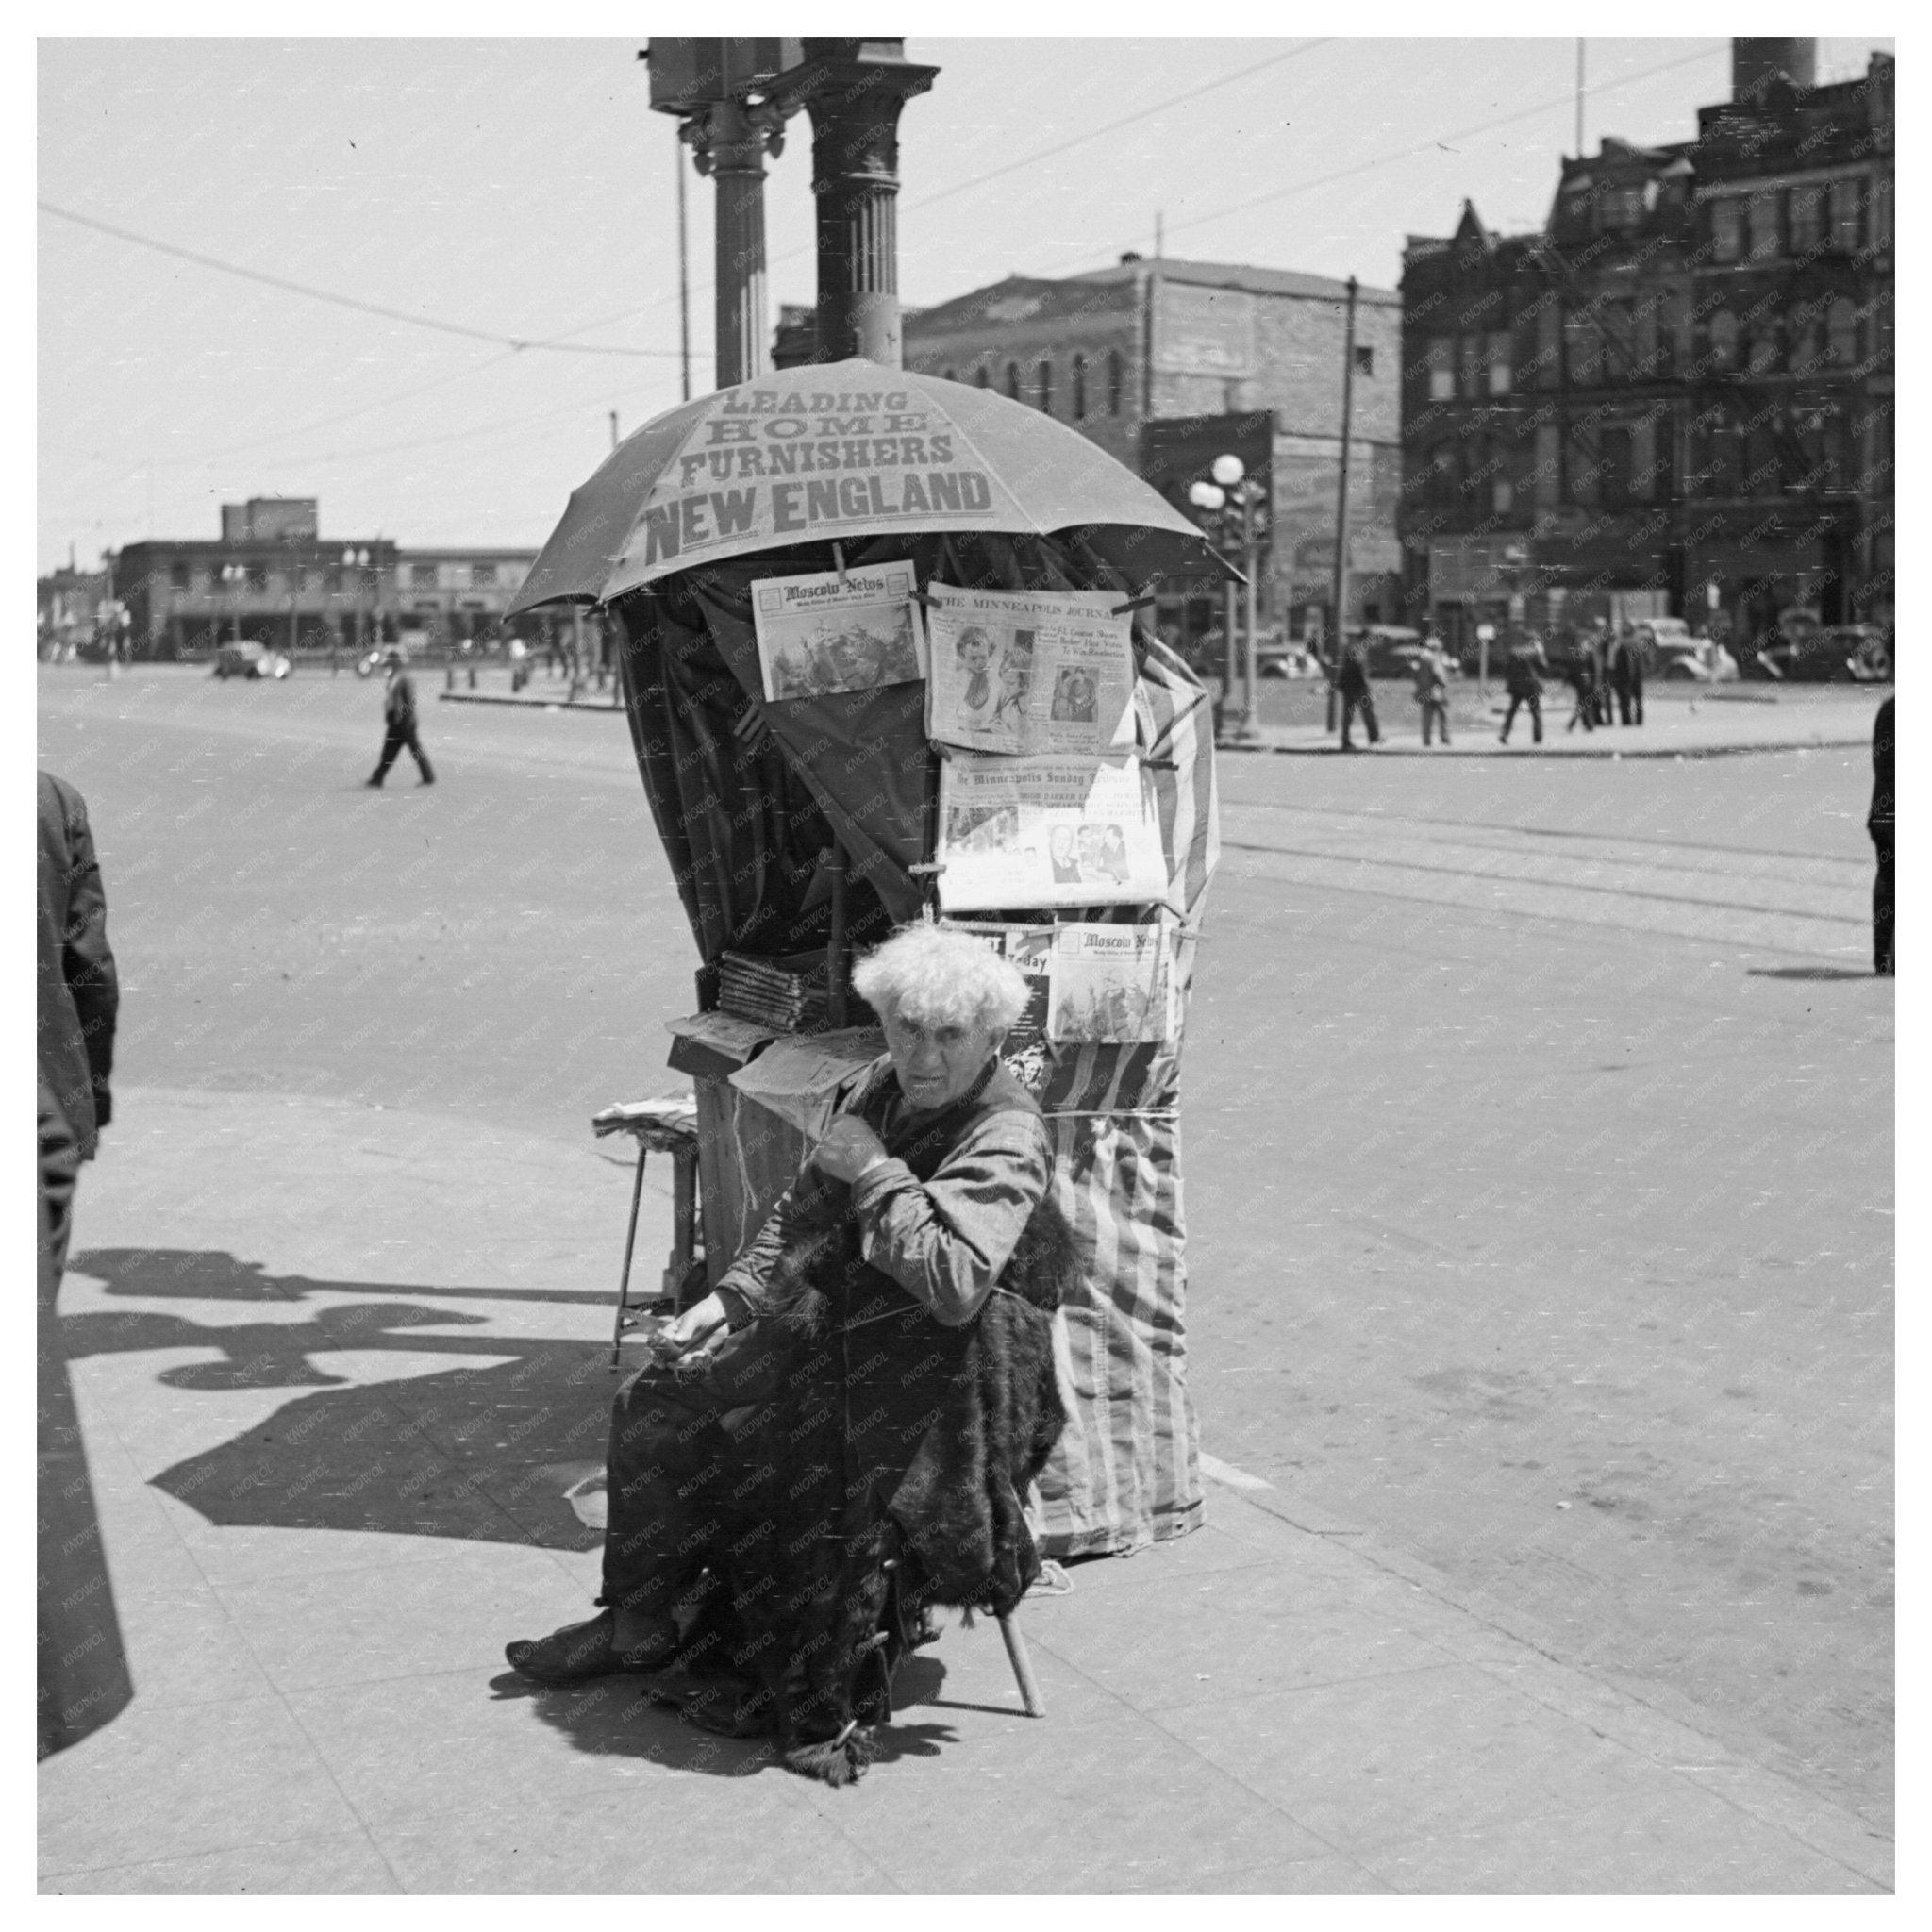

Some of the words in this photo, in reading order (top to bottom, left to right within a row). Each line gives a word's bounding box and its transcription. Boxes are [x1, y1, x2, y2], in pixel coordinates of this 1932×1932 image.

[723, 389, 908, 416] LEADING
[705, 413, 928, 445] HOME
[679, 435, 955, 489] FURNISHERS
[644, 486, 757, 566] NEW
[771, 471, 992, 534] ENGLAND
[784, 582, 840, 602] Moscow
[846, 577, 885, 593] News
[938, 595, 965, 607] THE
[973, 598, 1062, 614] MINNEAPOLIS
[974, 773, 1042, 787] Minneapolis
[1046, 771, 1085, 786] Sunday
[1084, 932, 1131, 948] Moscow
